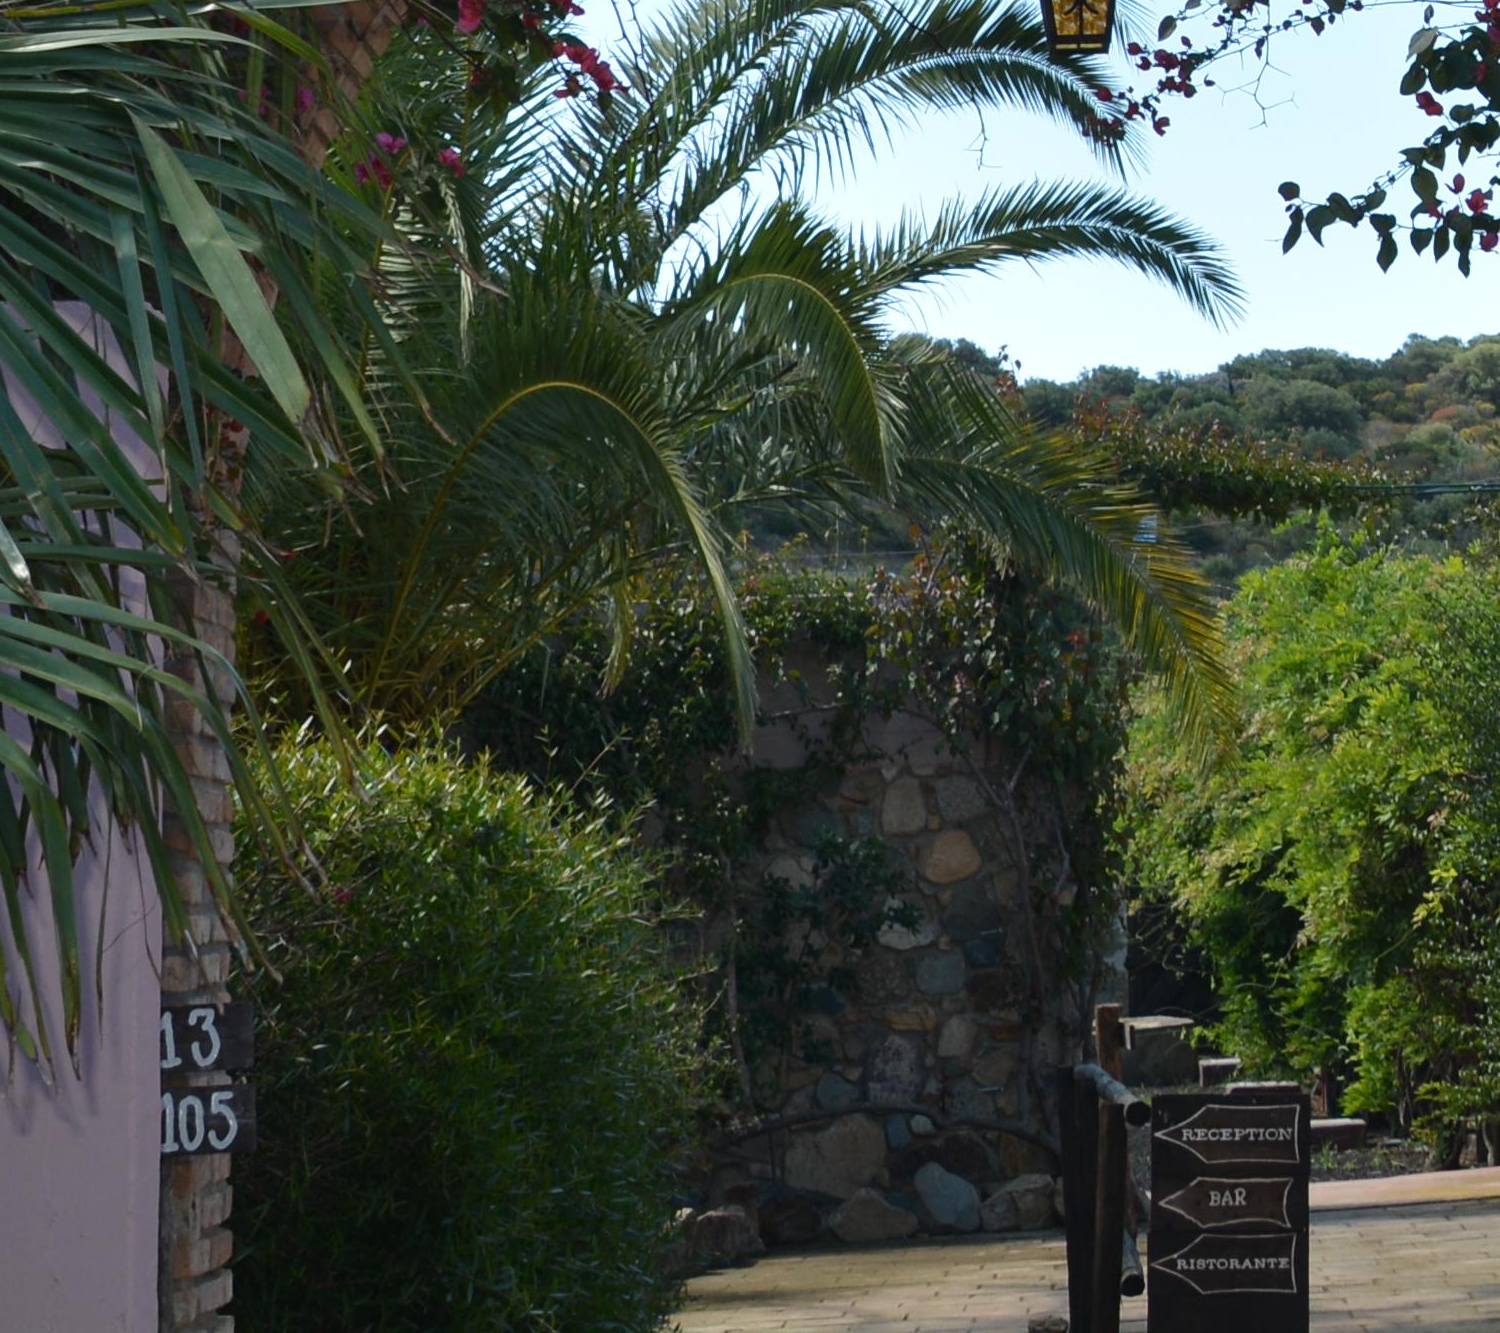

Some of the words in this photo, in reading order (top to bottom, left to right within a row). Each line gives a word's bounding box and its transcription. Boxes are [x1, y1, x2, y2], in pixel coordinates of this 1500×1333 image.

[160, 1007, 221, 1069] 13
[160, 1091, 238, 1153] 105
[1181, 1128, 1293, 1141] RECEPTION
[1209, 1188, 1247, 1206] BAR
[1176, 1257, 1290, 1270] RISTORANTE
